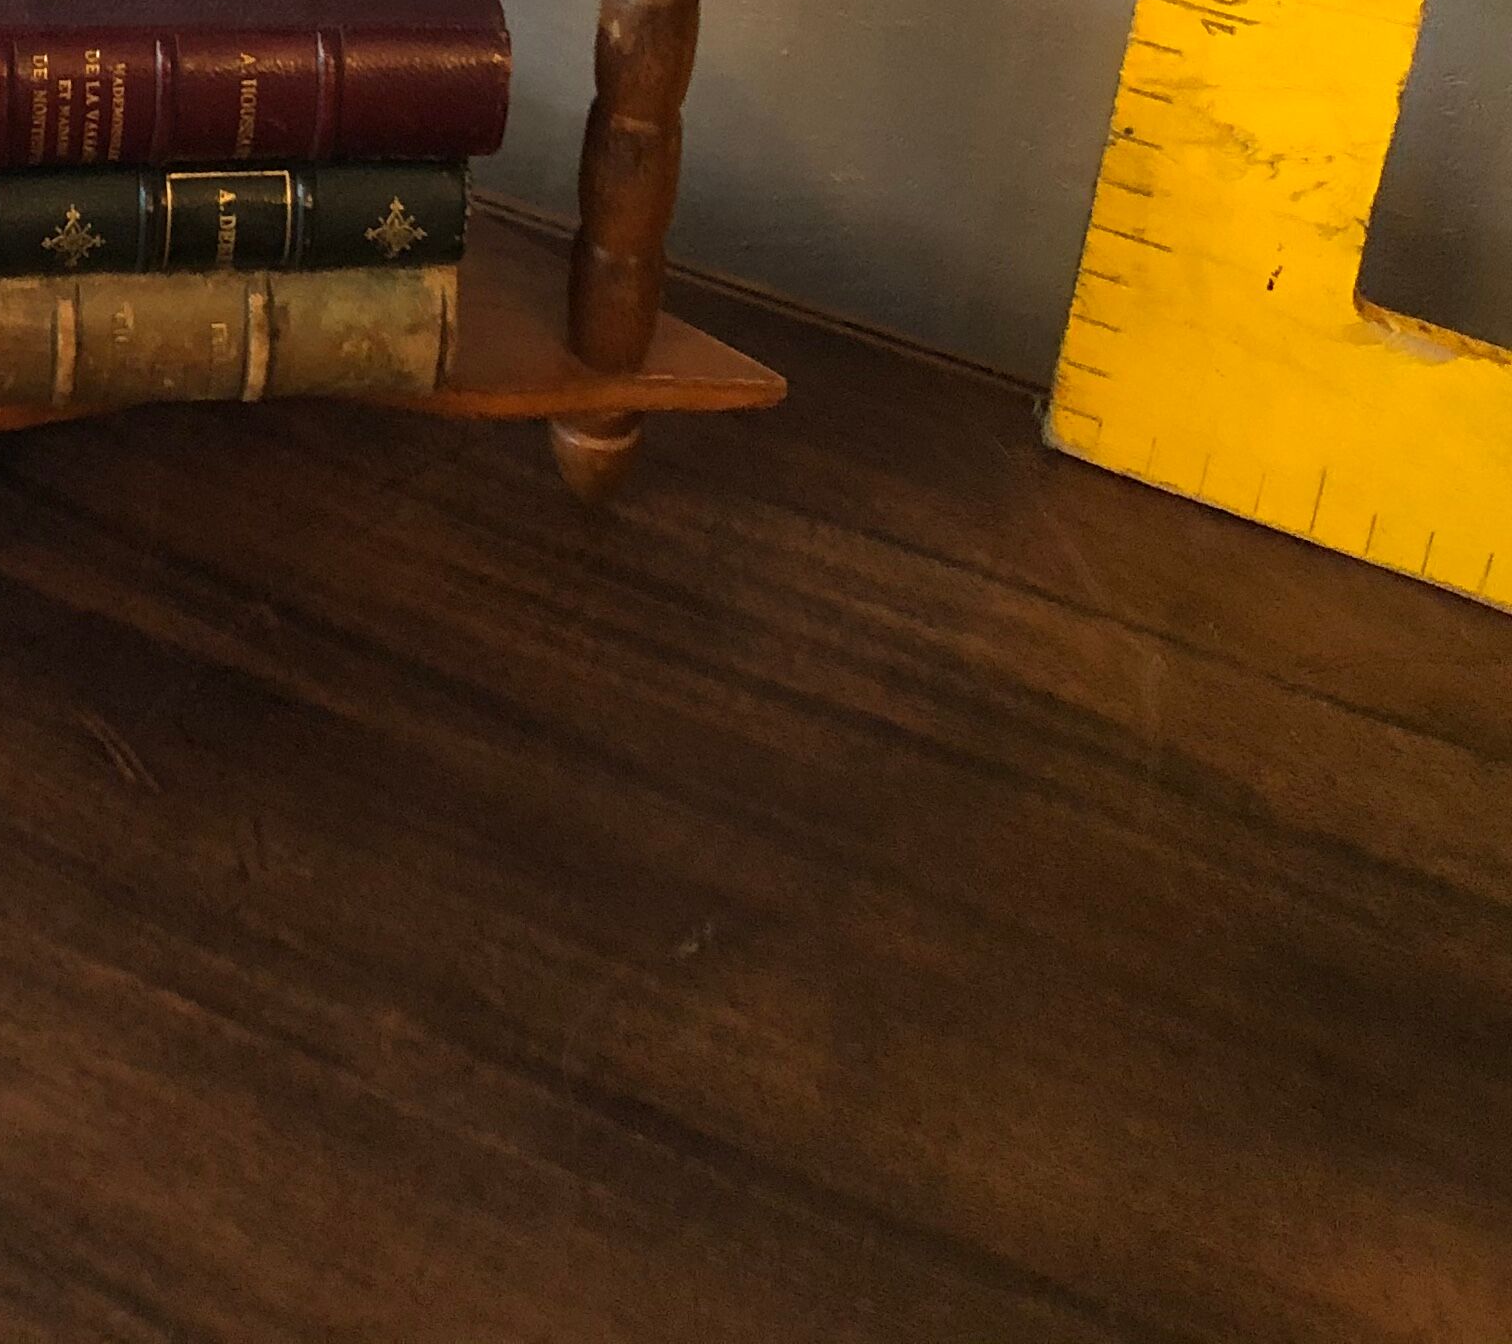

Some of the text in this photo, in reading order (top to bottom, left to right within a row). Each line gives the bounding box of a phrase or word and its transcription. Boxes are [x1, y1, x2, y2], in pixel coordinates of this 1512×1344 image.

[32, 53, 48, 80] DE
[84, 49, 101, 75] DE
[57, 79, 72, 100] ET
[85, 80, 101, 105] LA
[218, 188, 236, 212] A.
